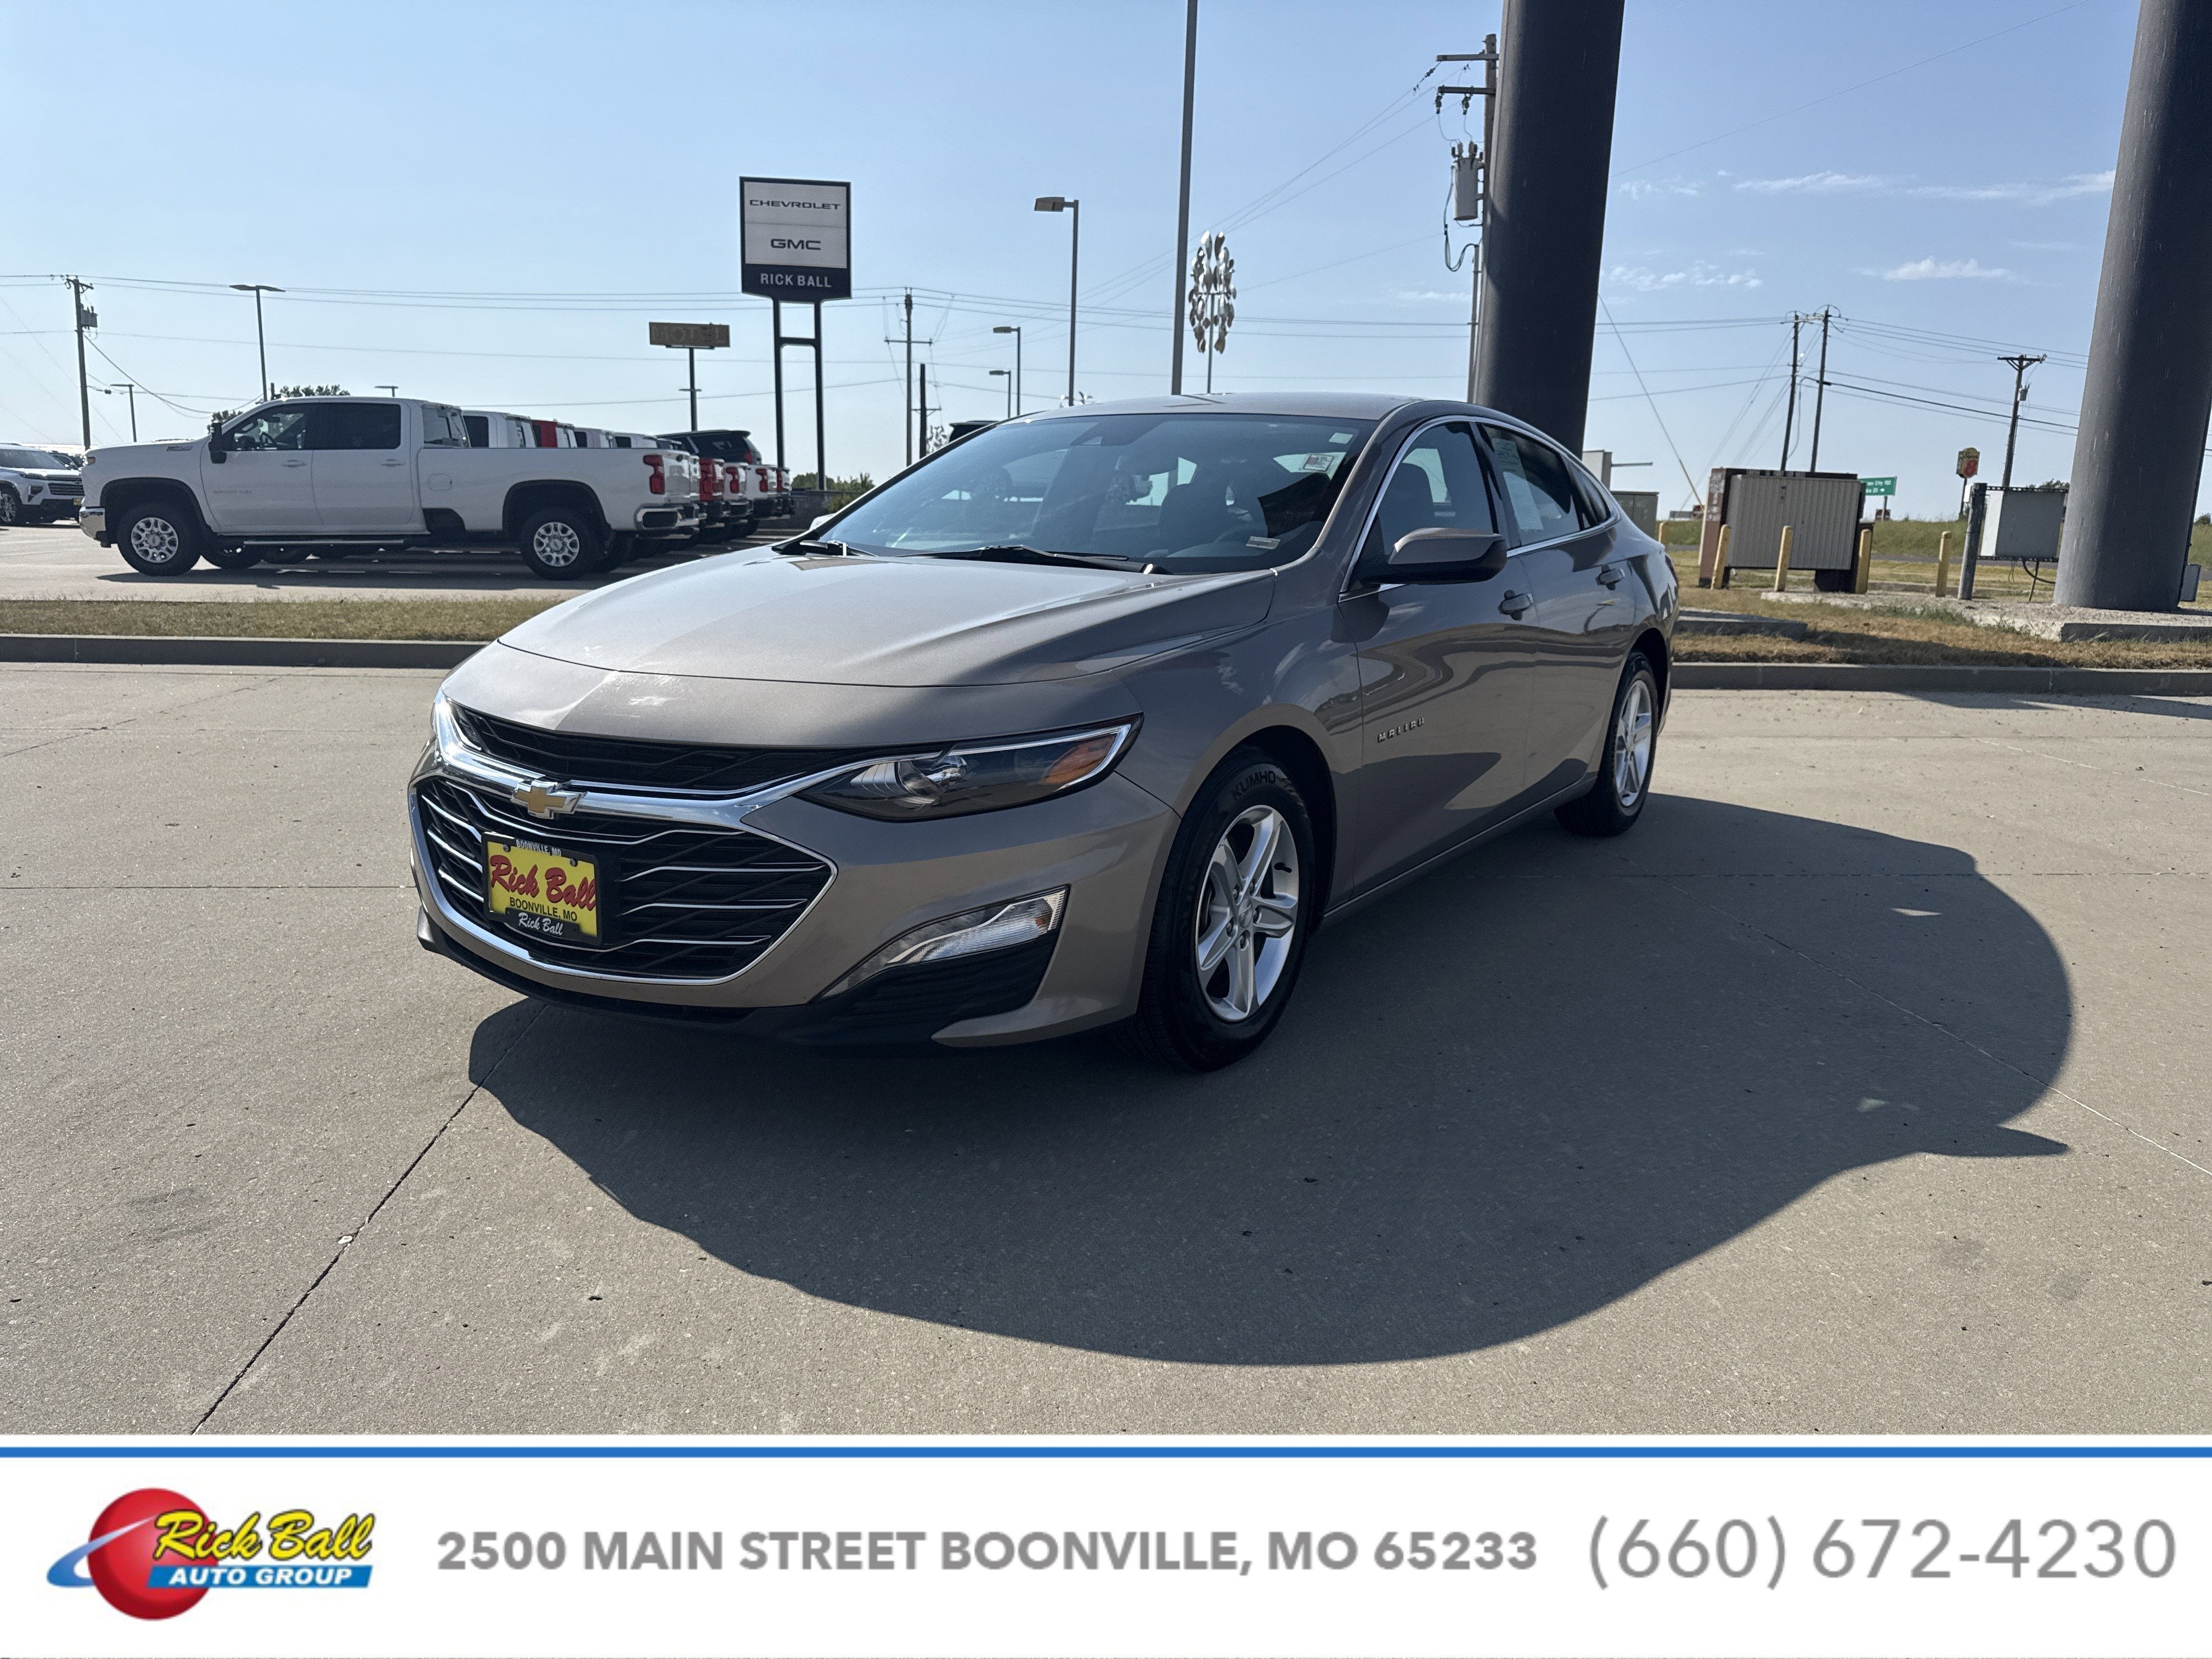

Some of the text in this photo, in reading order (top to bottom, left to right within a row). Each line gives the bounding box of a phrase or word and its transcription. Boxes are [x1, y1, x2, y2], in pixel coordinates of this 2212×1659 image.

[749, 199, 841, 210] CHEVROLET
[770, 238, 821, 251] GMC
[760, 273, 832, 288] RICK BALL
[1229, 770, 1276, 800] KUMHO
[516, 839, 562, 857] BOONVILLE, MO
[490, 855, 596, 911] Rick Ball
[509, 896, 578, 922] BOONVILLE, MO
[518, 912, 564, 936] Rick Ball
